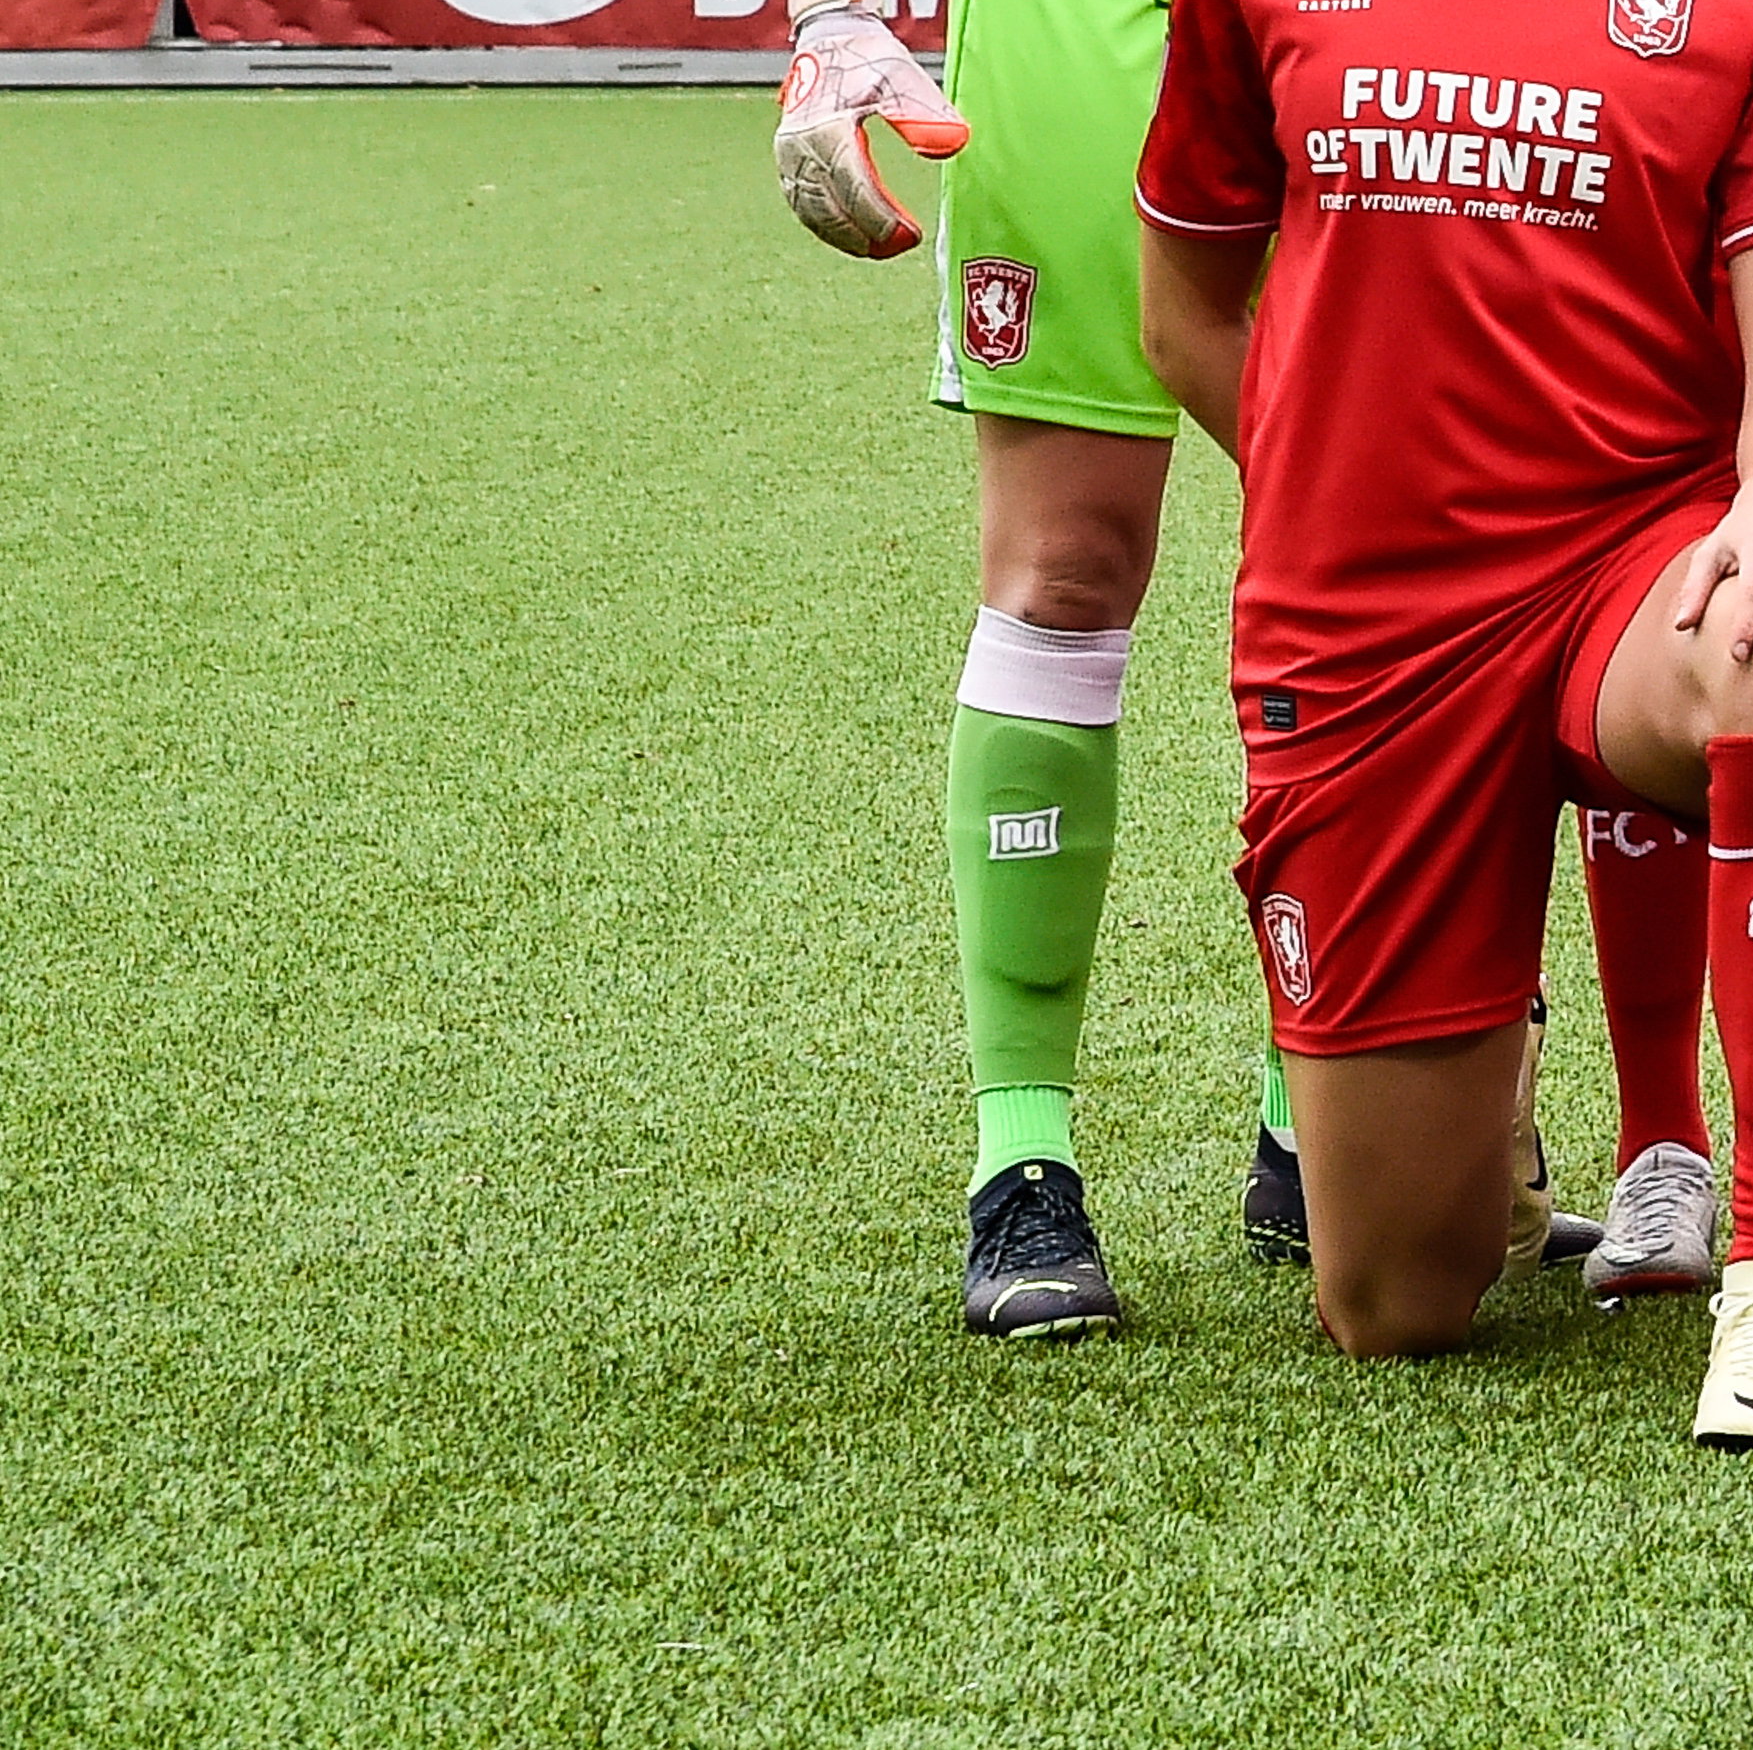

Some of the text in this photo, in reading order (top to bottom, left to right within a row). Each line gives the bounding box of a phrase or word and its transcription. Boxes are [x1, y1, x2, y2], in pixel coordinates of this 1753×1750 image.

[1342, 67, 1604, 143] FUTURE
[1307, 127, 1612, 204] OF TWENTE
[1361, 193, 1459, 216] vrouwen.
[1463, 198, 1519, 222] meer
[1522, 201, 1599, 231] kracht.
[1586, 808, 1688, 862] FC
